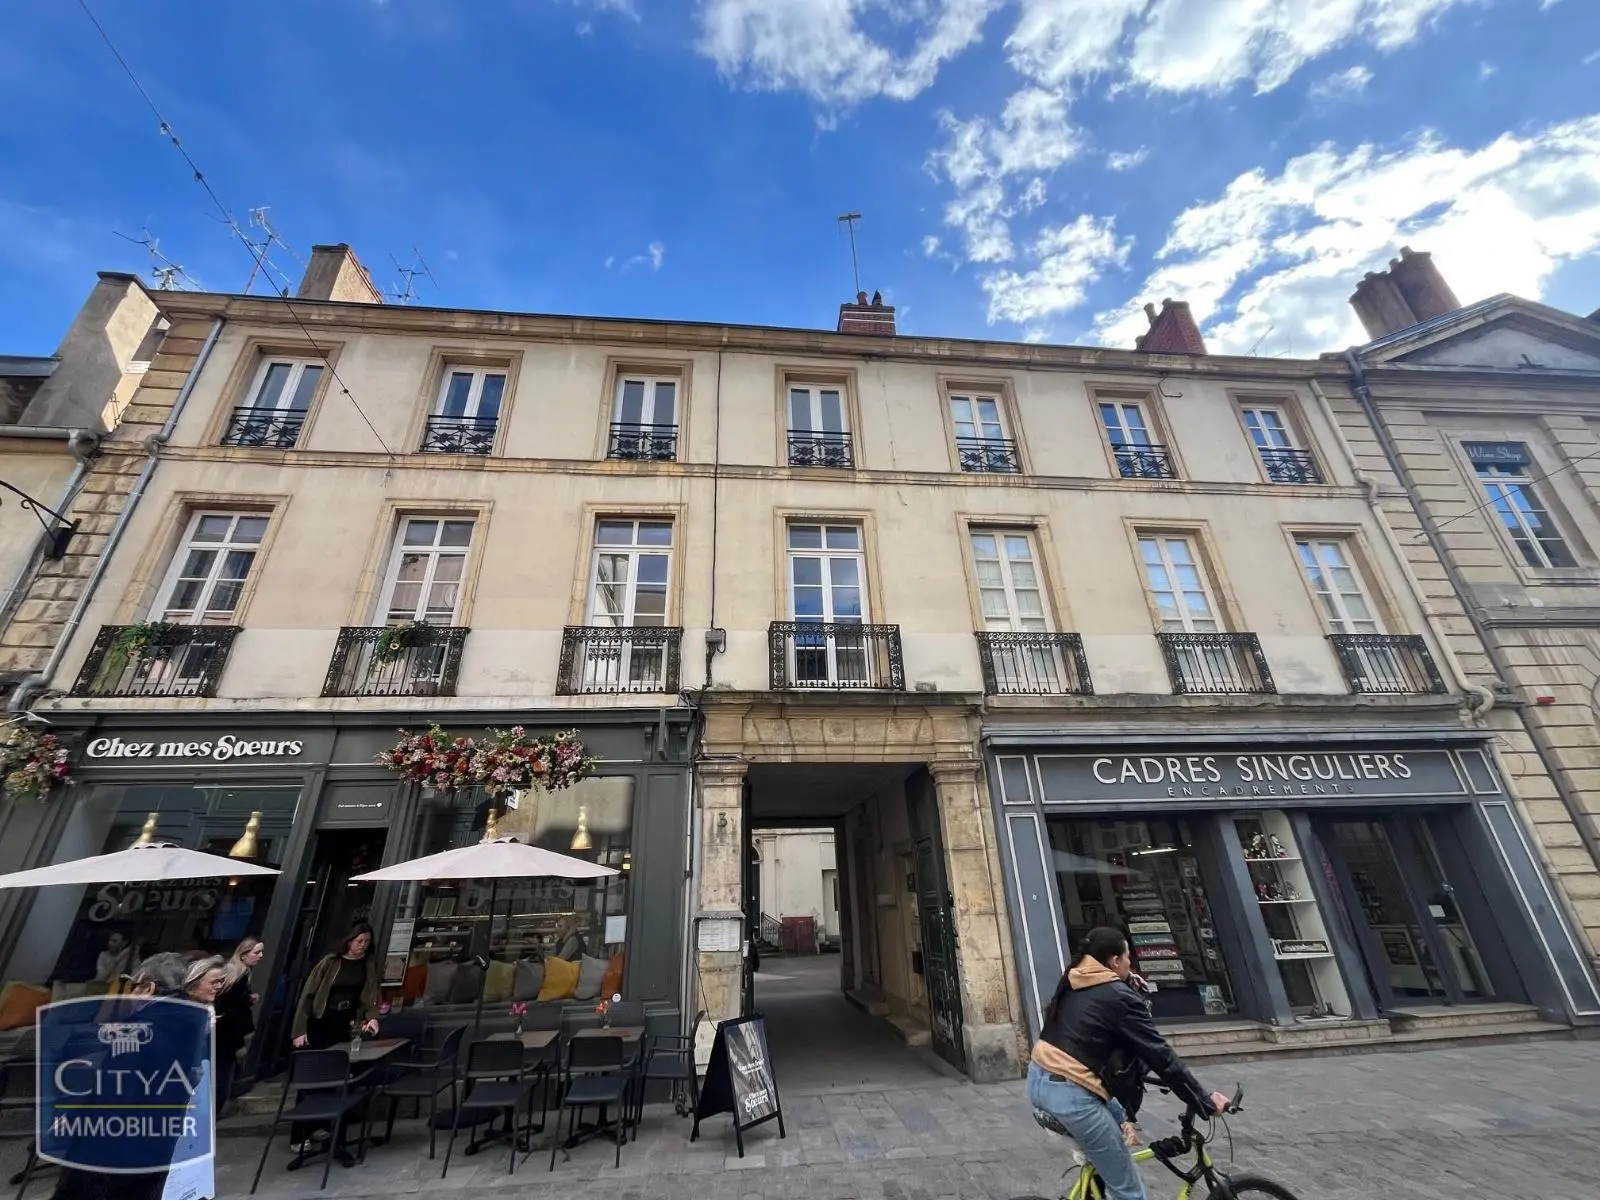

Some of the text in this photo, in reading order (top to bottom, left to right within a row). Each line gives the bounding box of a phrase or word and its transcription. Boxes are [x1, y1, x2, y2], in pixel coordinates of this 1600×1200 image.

[86, 737, 154, 758] Chez
[156, 741, 213, 757] mes
[1092, 753, 1412, 784] CADRES SINGULIERS
[1166, 783, 1355, 797] ENCADREMENTS
